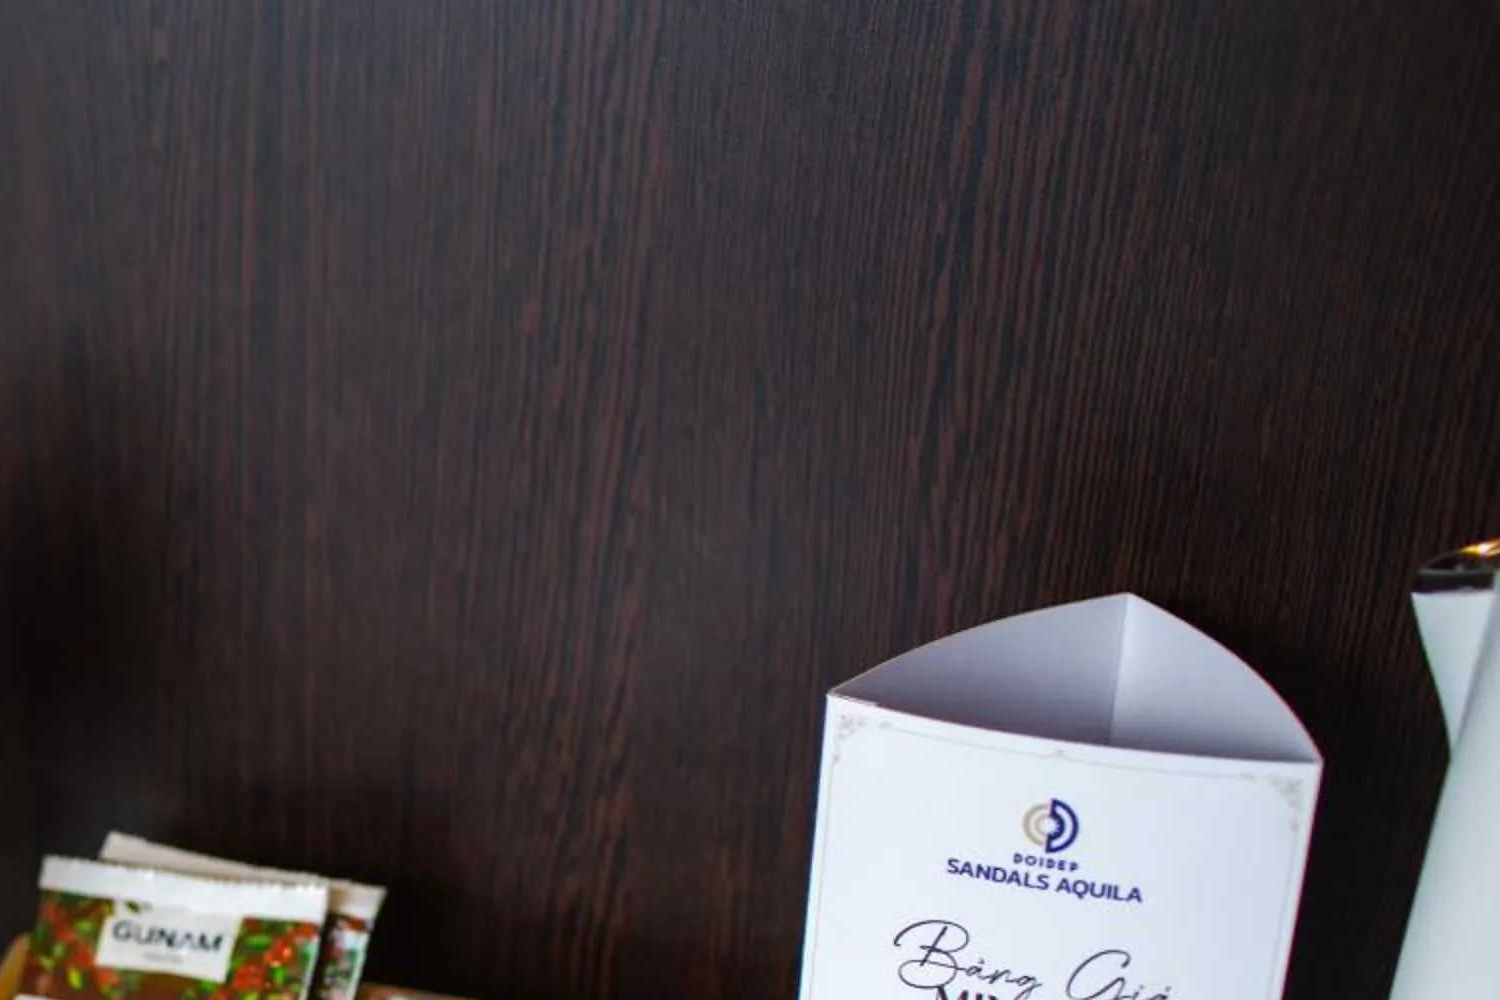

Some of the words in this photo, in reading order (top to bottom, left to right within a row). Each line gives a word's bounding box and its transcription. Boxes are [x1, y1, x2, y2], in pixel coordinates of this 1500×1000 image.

[947, 858, 1050, 891] SANDALS
[1056, 878, 1143, 903] AQUILA
[112, 919, 224, 953] GUNAM
